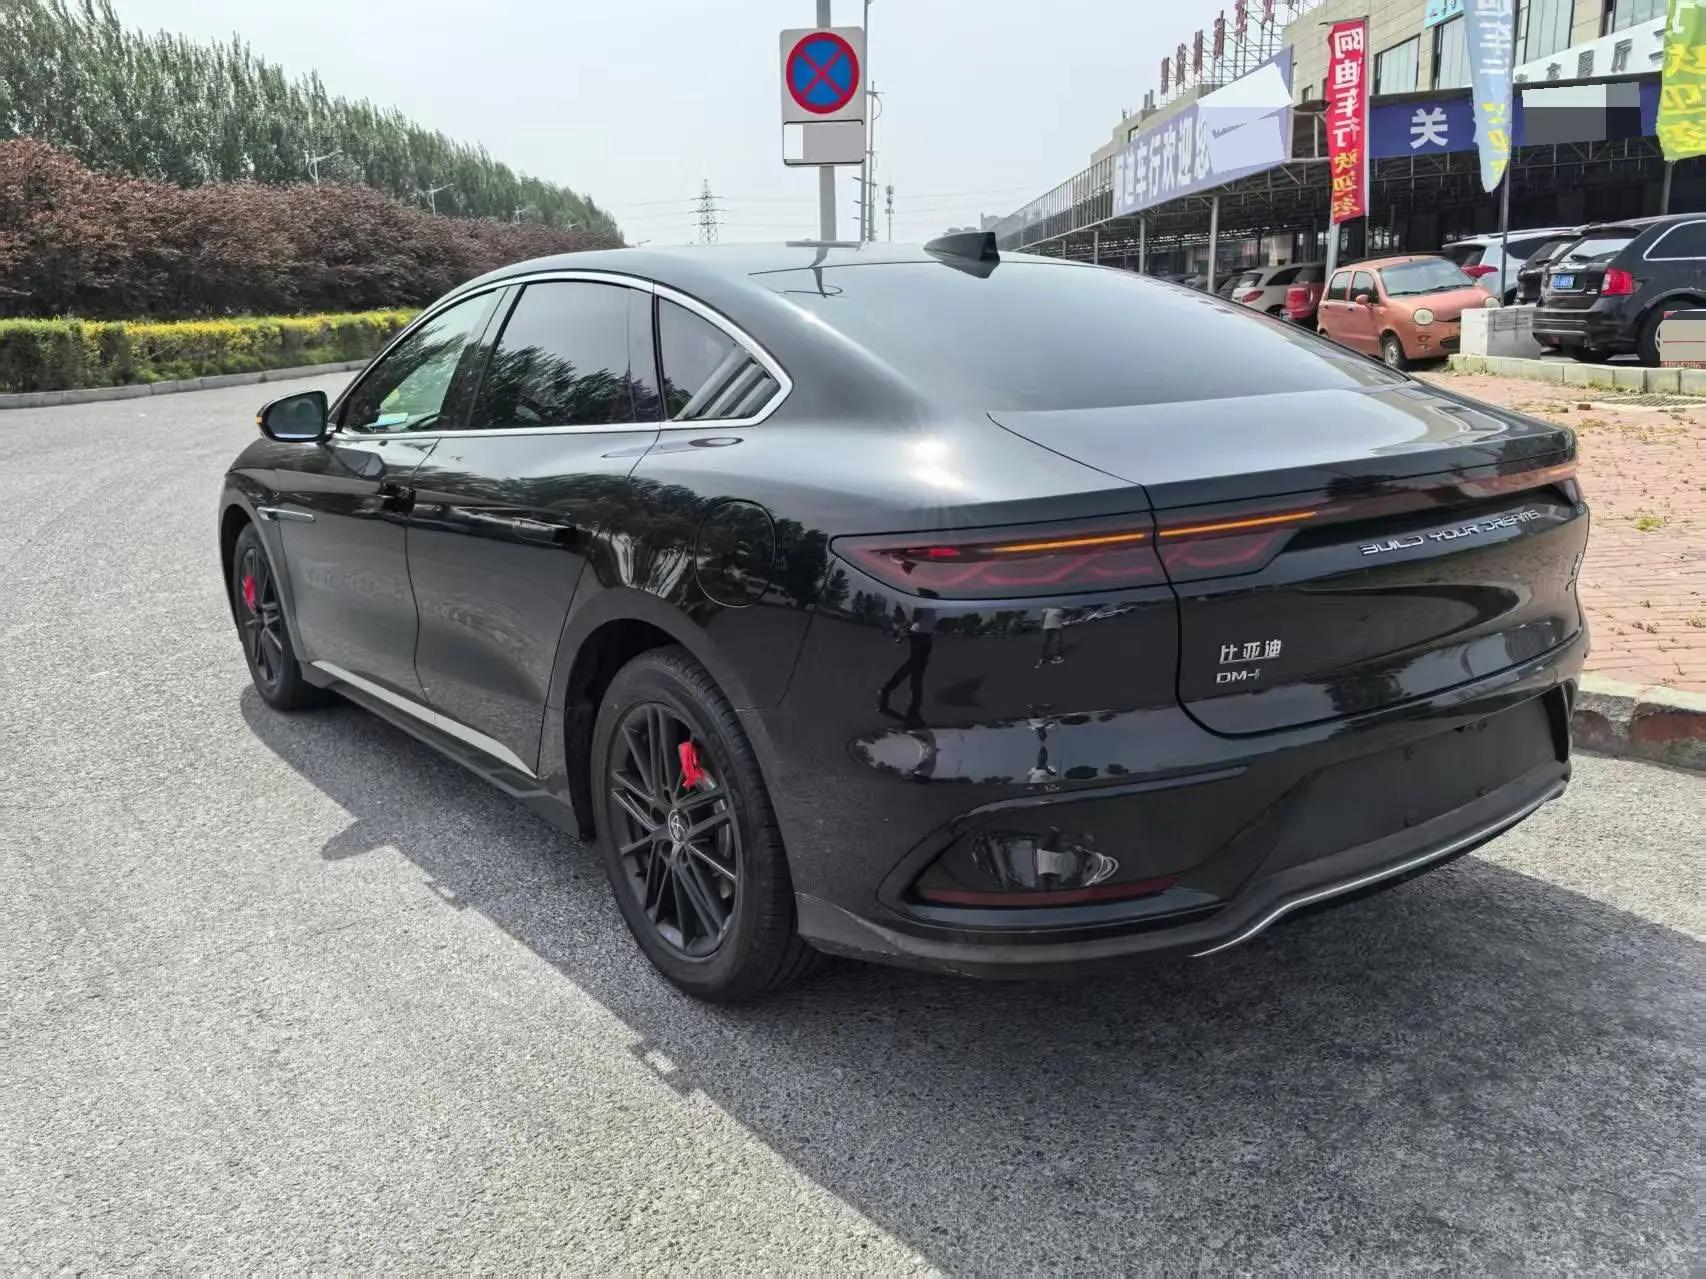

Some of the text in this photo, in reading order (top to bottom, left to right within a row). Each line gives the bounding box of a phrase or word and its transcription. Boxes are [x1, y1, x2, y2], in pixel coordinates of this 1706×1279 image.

[1360, 509, 1542, 556] BUILD YOUR DREAMS
[1219, 639, 1281, 664] 比亚迪
